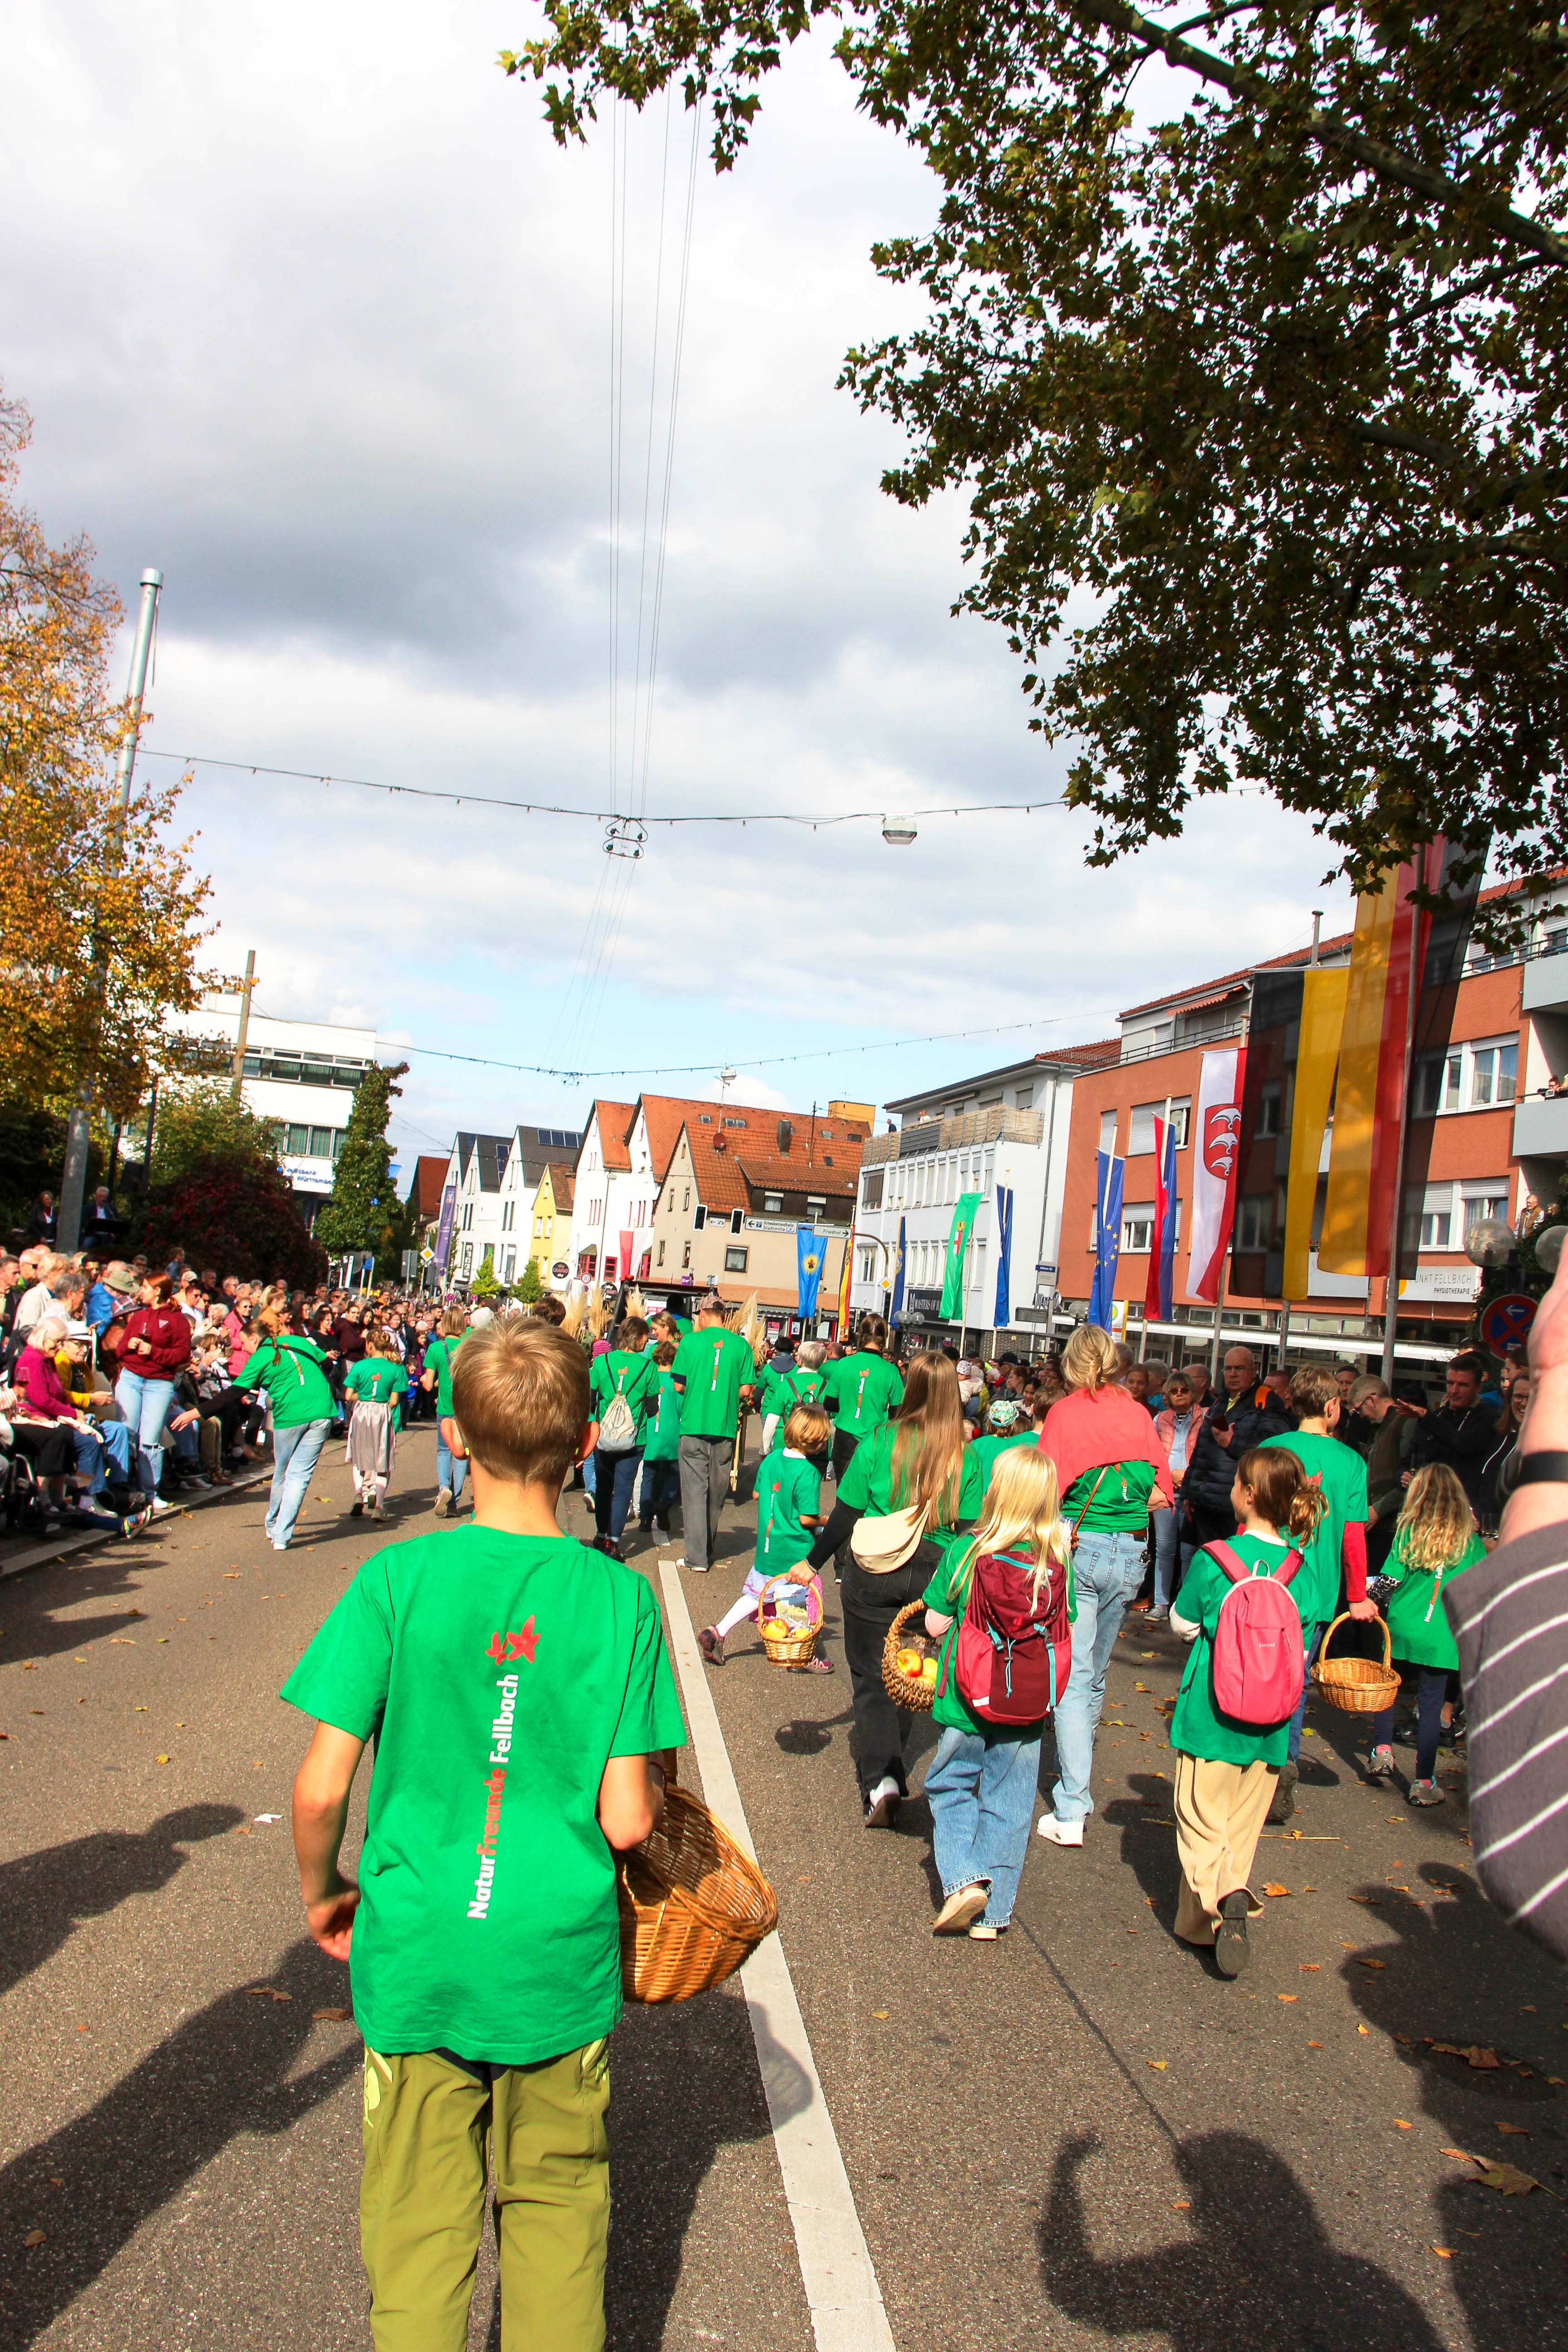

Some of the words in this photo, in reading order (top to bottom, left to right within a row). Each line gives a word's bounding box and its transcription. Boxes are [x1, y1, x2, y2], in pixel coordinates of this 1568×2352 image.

[1435, 1274, 1471, 1284] FELLBACH
[931, 1300, 936, 1310] OF
[466, 1768, 507, 1920] NaturFreunde
[489, 1673, 519, 1764] Fellbach
